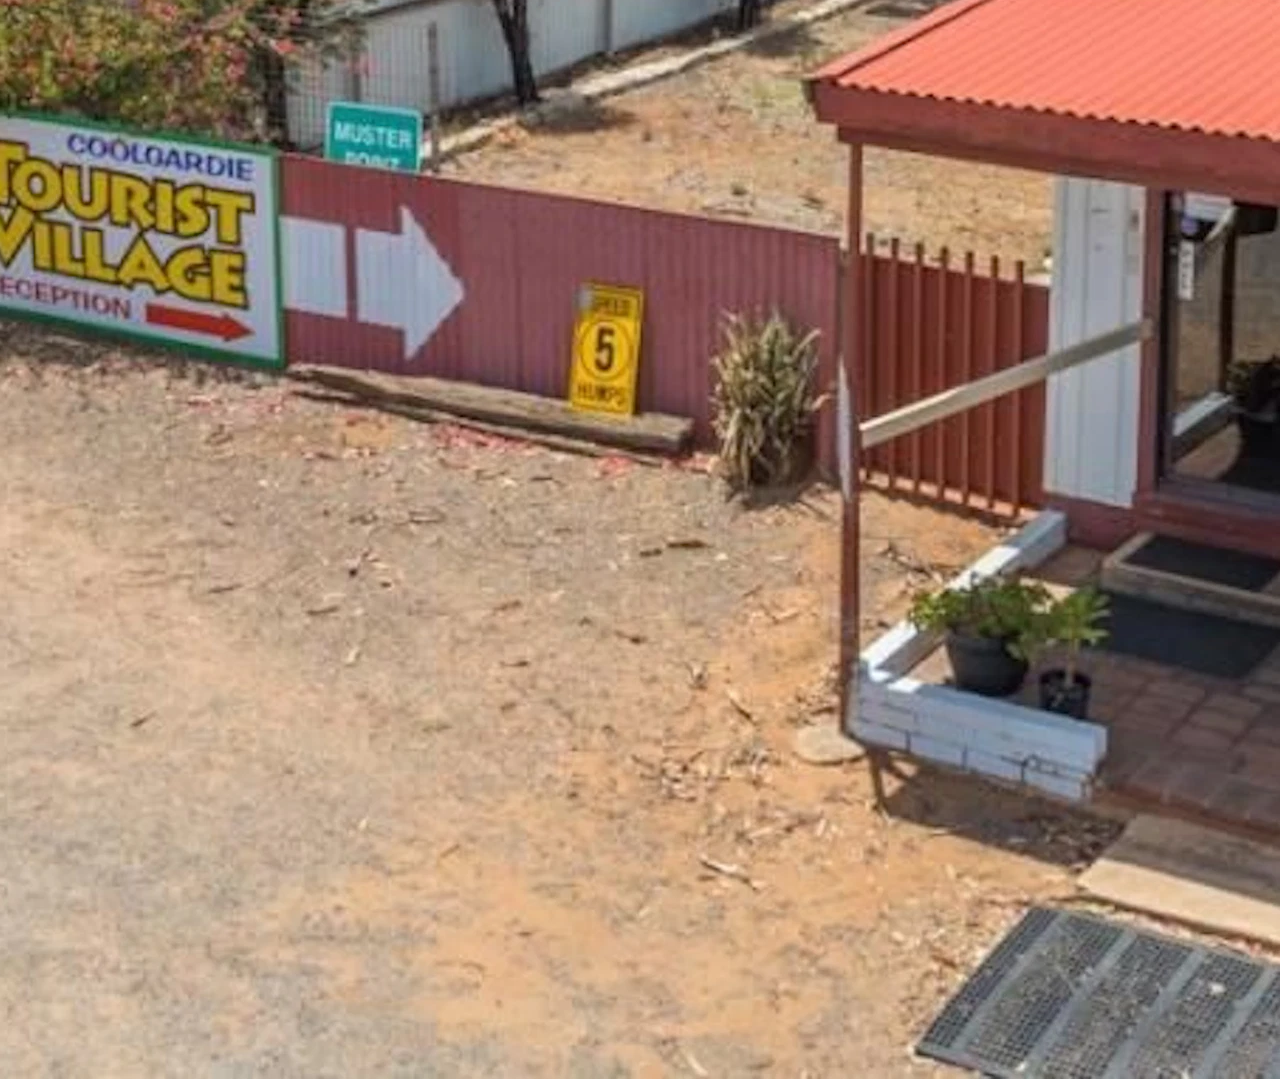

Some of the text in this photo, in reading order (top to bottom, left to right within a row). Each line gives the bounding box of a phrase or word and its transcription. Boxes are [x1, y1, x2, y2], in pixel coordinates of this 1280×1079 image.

[334, 121, 411, 149] MUSTER
[67, 133, 254, 182] COOLGARDIE
[594, 326, 616, 372] 5
[577, 382, 627, 407] HUMPS
